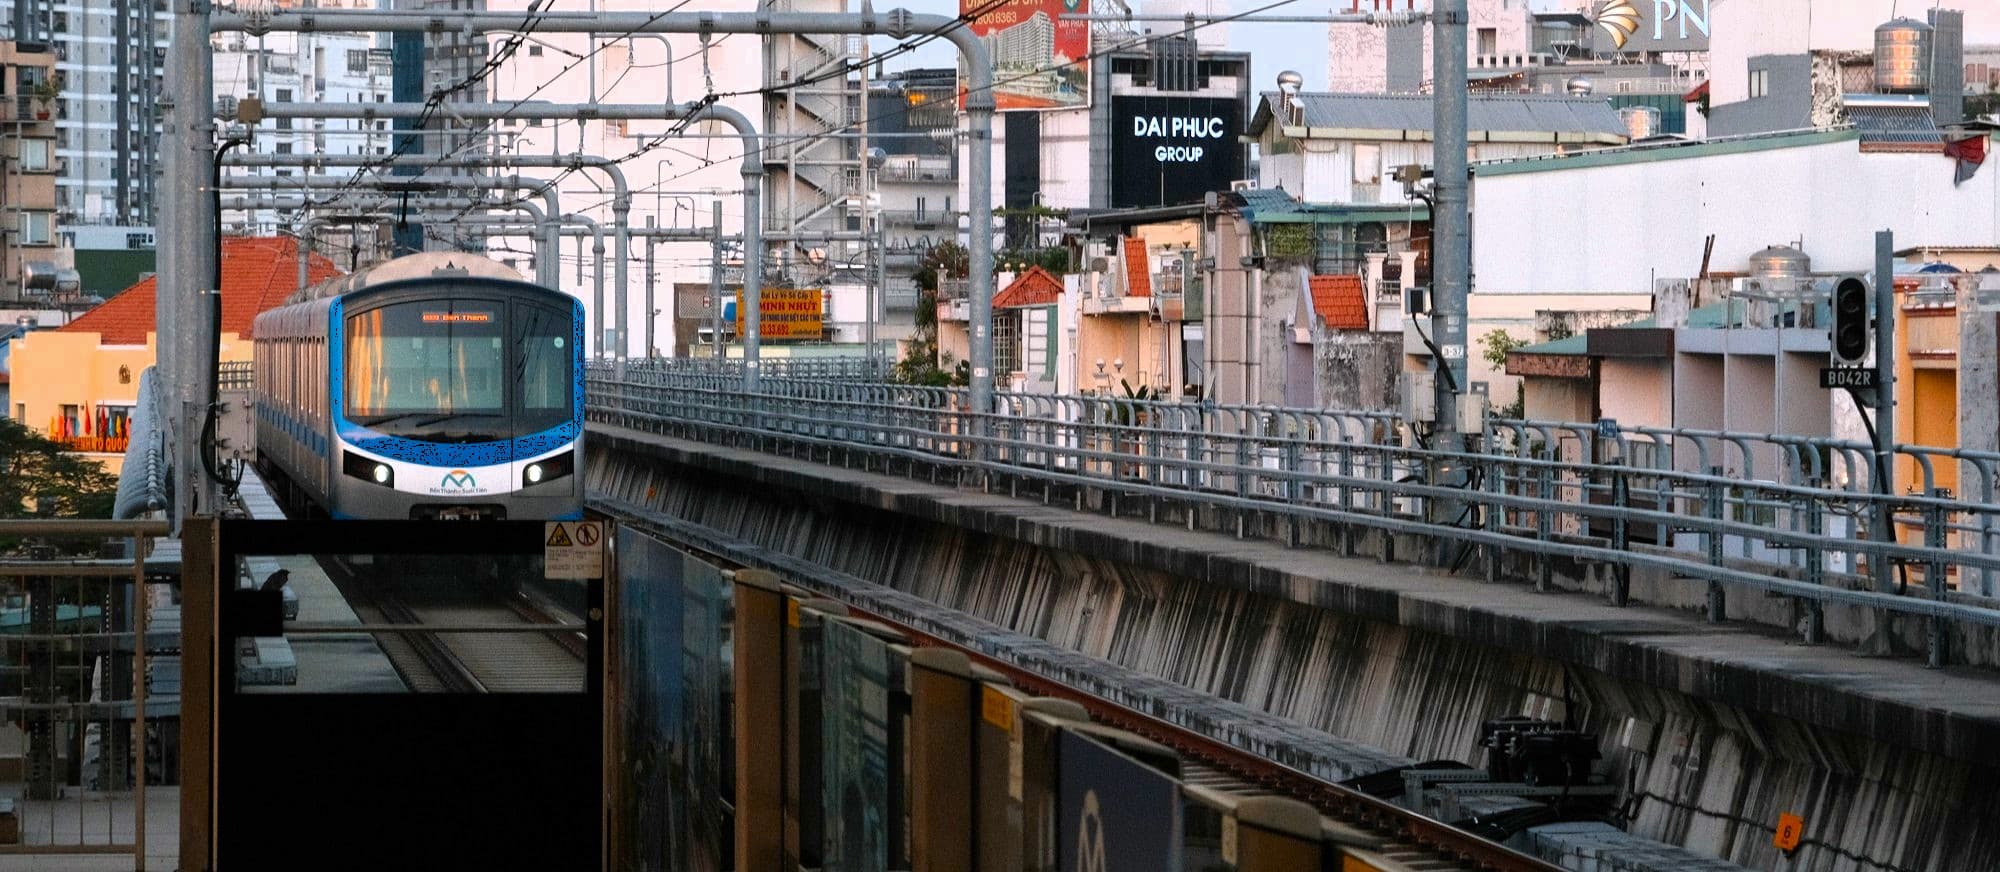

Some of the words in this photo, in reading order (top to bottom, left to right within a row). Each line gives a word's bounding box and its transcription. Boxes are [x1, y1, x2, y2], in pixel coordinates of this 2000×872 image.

[995, 12, 1017, 23] 6363
[1134, 116, 1167, 137] DAI
[1172, 117, 1224, 138] PHUC
[1155, 146, 1203, 162] GROUP
[1828, 371, 1871, 385] B042R
[1784, 825, 1792, 839] 6
